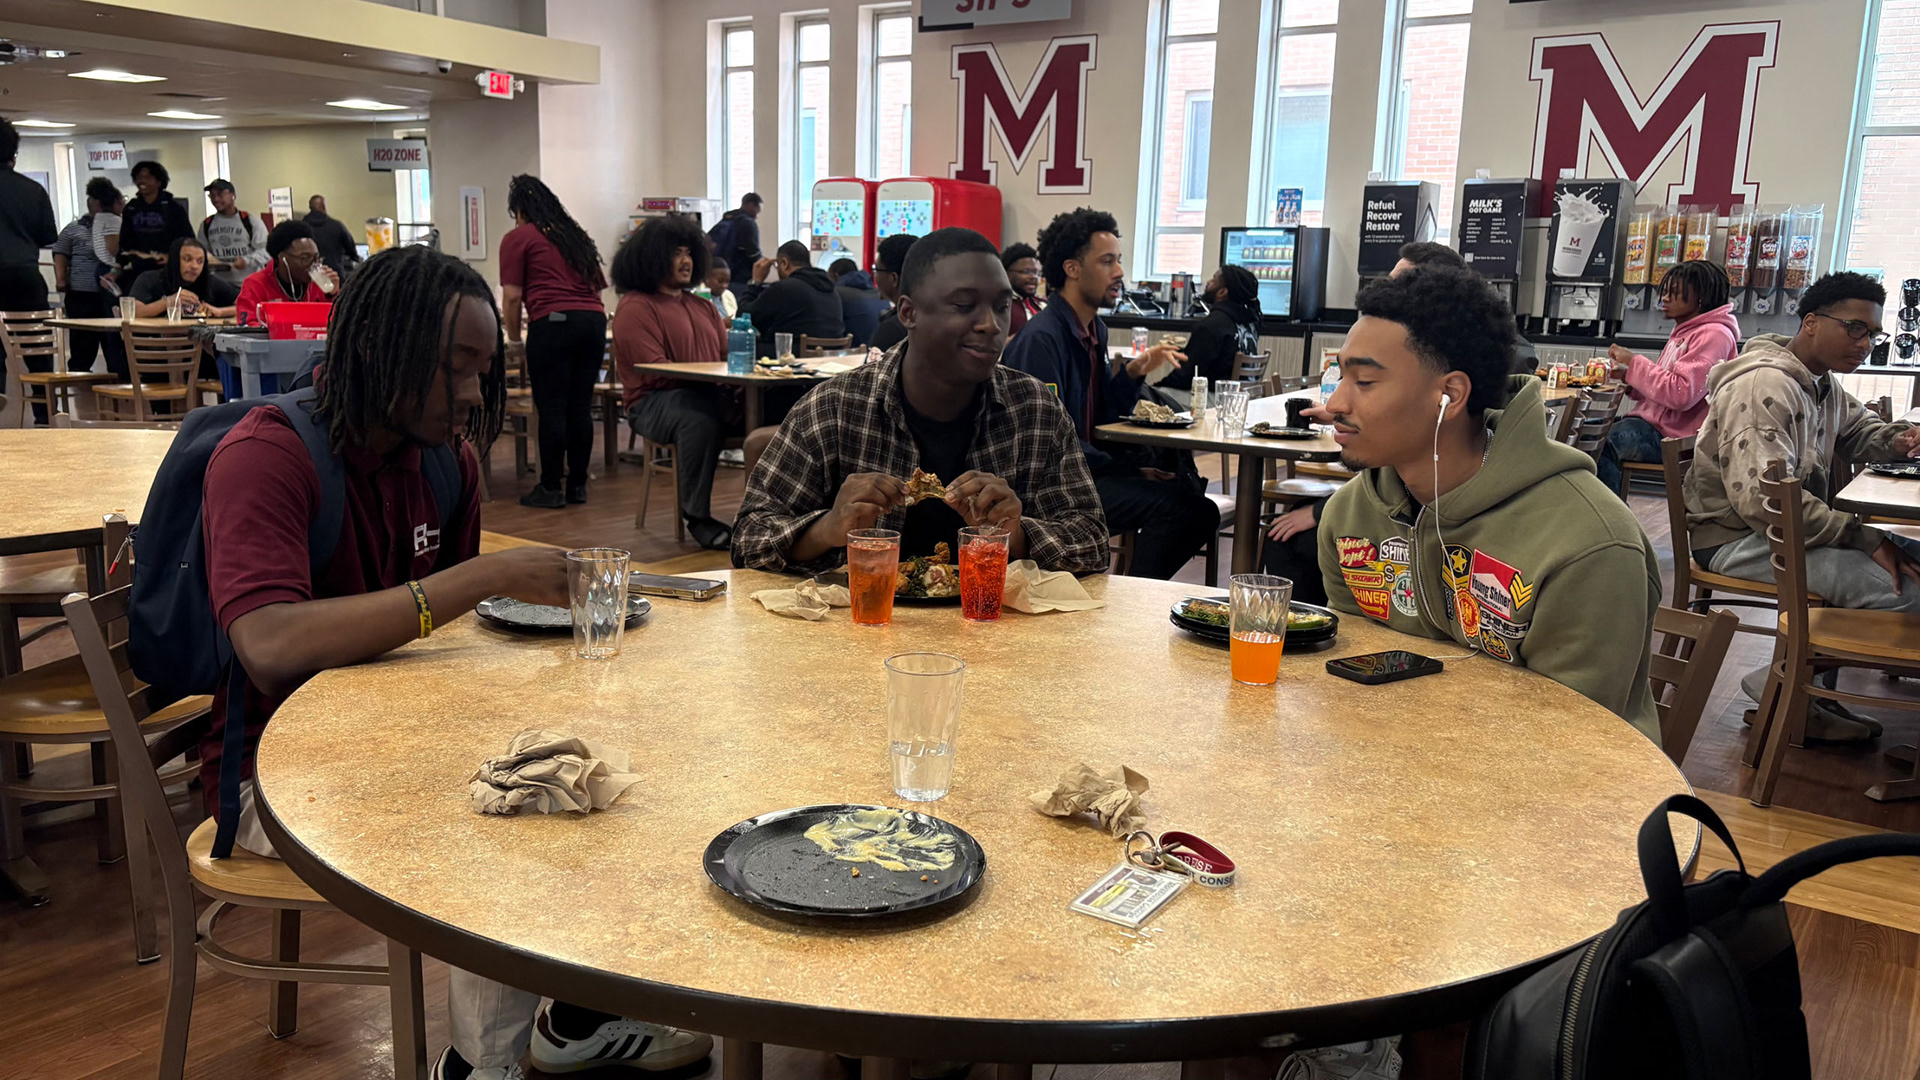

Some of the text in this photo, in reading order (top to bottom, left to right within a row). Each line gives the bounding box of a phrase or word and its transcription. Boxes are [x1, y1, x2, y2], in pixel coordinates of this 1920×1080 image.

[948, 34, 1098, 195] M
[1530, 20, 1781, 226] M
[89, 150, 123, 161] TOP IT OFF
[394, 148, 421, 161] ZONE
[1367, 200, 1396, 210] Refuel
[1469, 199, 1503, 208] MILK'S
[1367, 211, 1402, 221] Recover
[1366, 221, 1400, 231] Restore
[1569, 236, 1581, 247] M
[1472, 574, 1511, 609] Young Shiner
